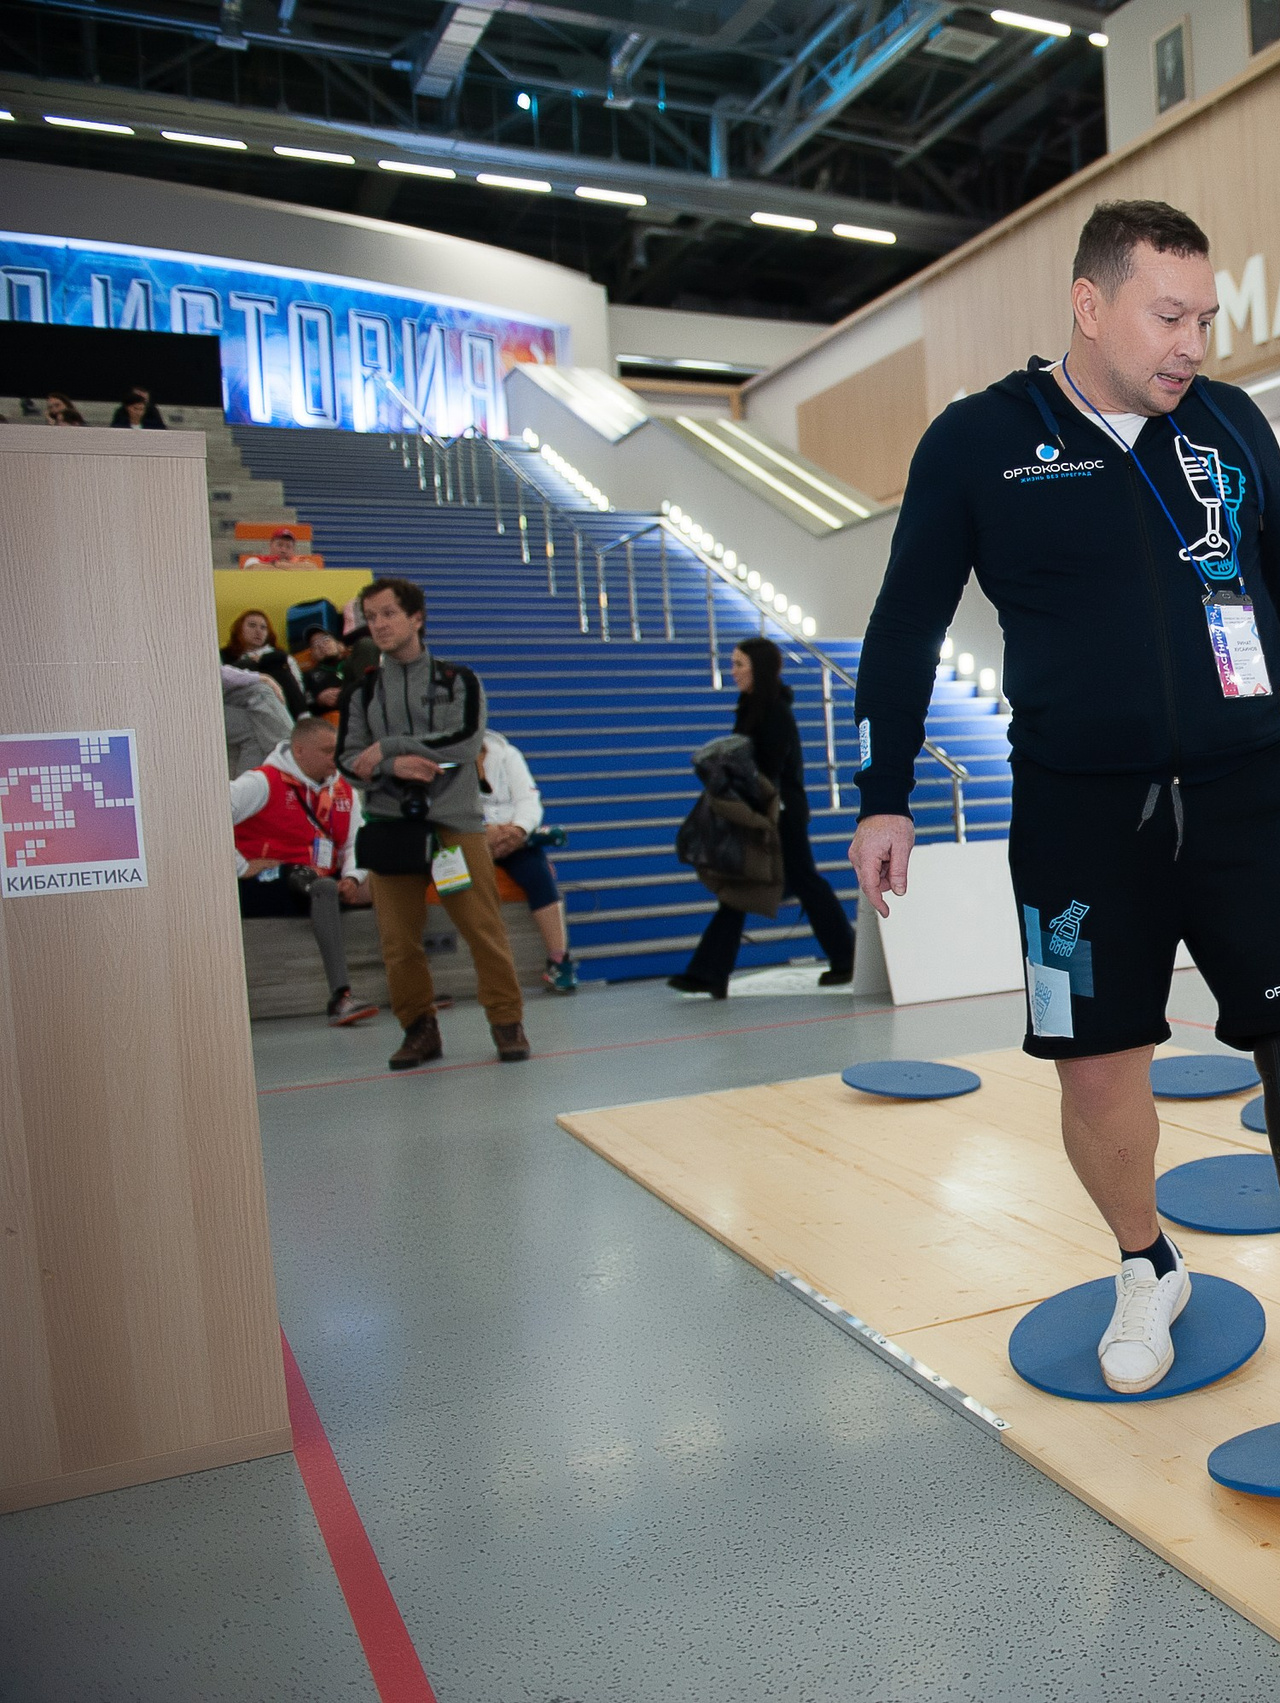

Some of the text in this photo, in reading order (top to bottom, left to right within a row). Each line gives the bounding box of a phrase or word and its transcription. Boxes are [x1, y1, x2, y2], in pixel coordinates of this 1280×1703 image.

[1003, 460, 1104, 479] ОРТОКОСМОС
[1020, 475, 1044, 483] ЖИЗНЬ
[7, 868, 142, 892] КИБАТЛЕТИКА
